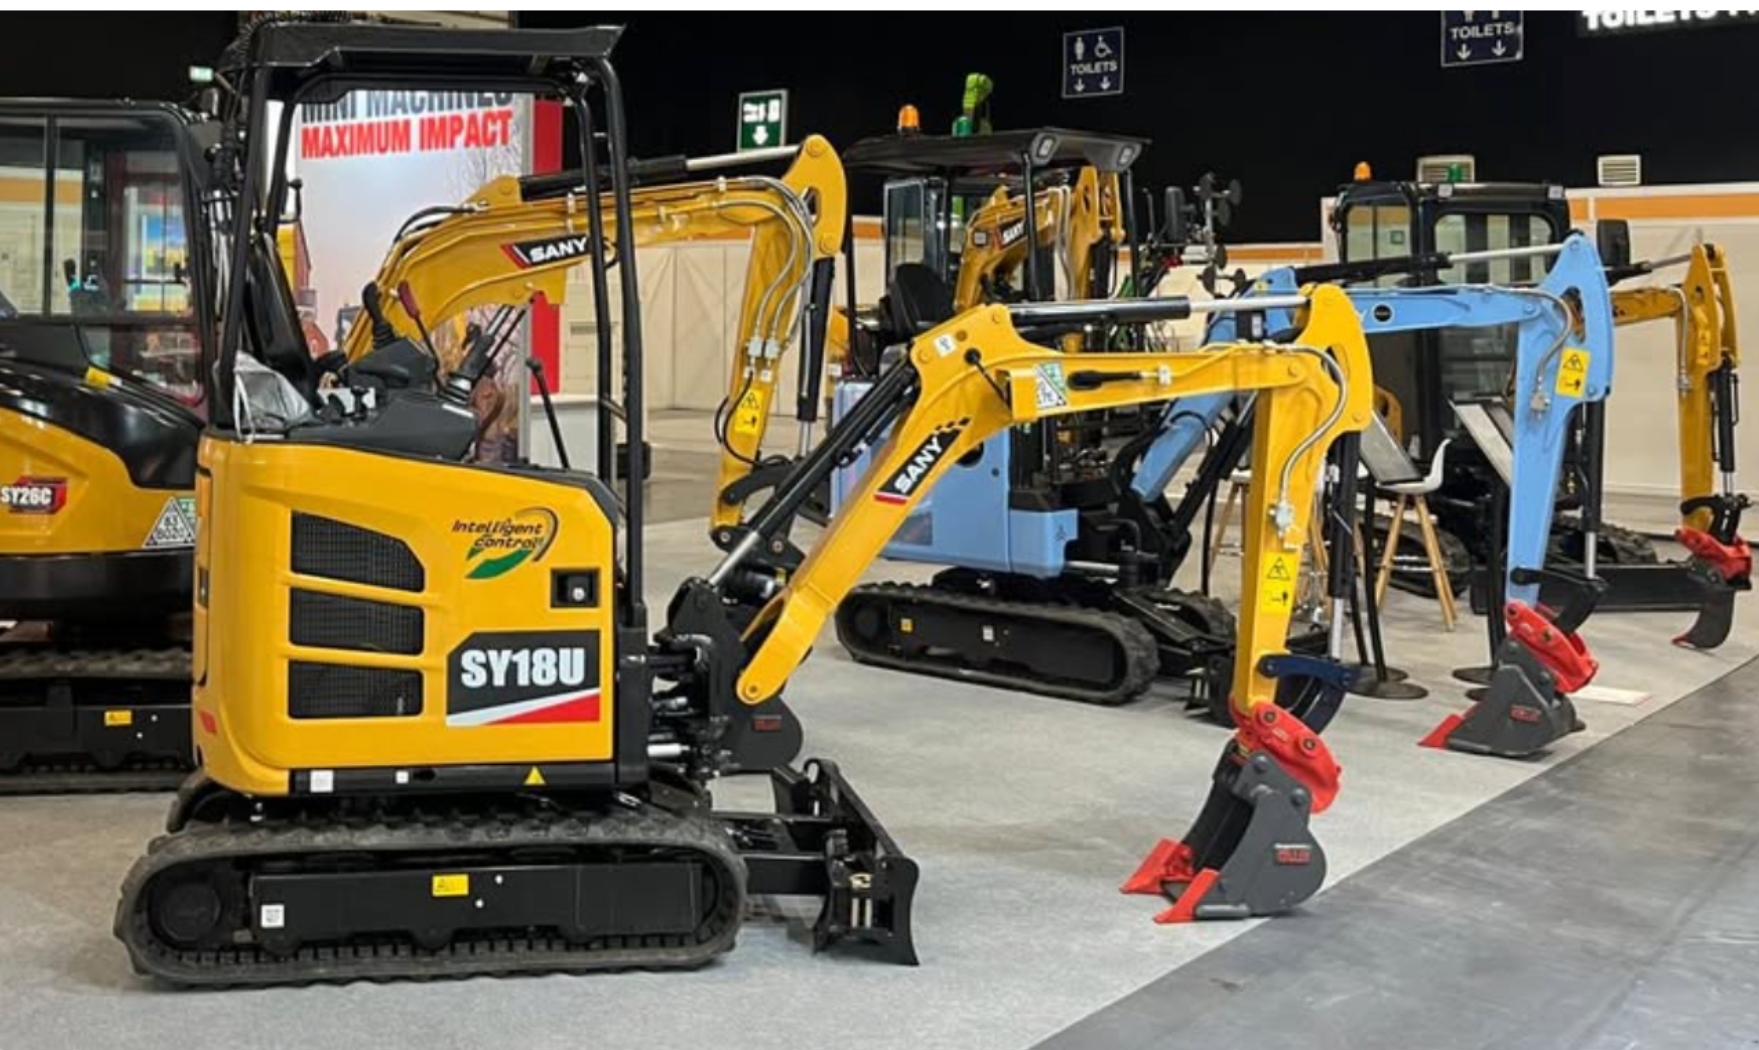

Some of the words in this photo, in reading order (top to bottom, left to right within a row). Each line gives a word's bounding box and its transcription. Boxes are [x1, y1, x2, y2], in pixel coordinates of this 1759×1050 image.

[1449, 21, 1514, 40] TOILETS
[1070, 60, 1117, 75] TOILETS
[302, 119, 411, 159] MAXIMUM
[419, 108, 513, 152] IMPACT
[529, 237, 588, 262] SANY
[894, 436, 942, 494] SANY
[1, 486, 52, 505] SY26C
[452, 518, 543, 537] Intelligent
[461, 648, 585, 688] SY18U
